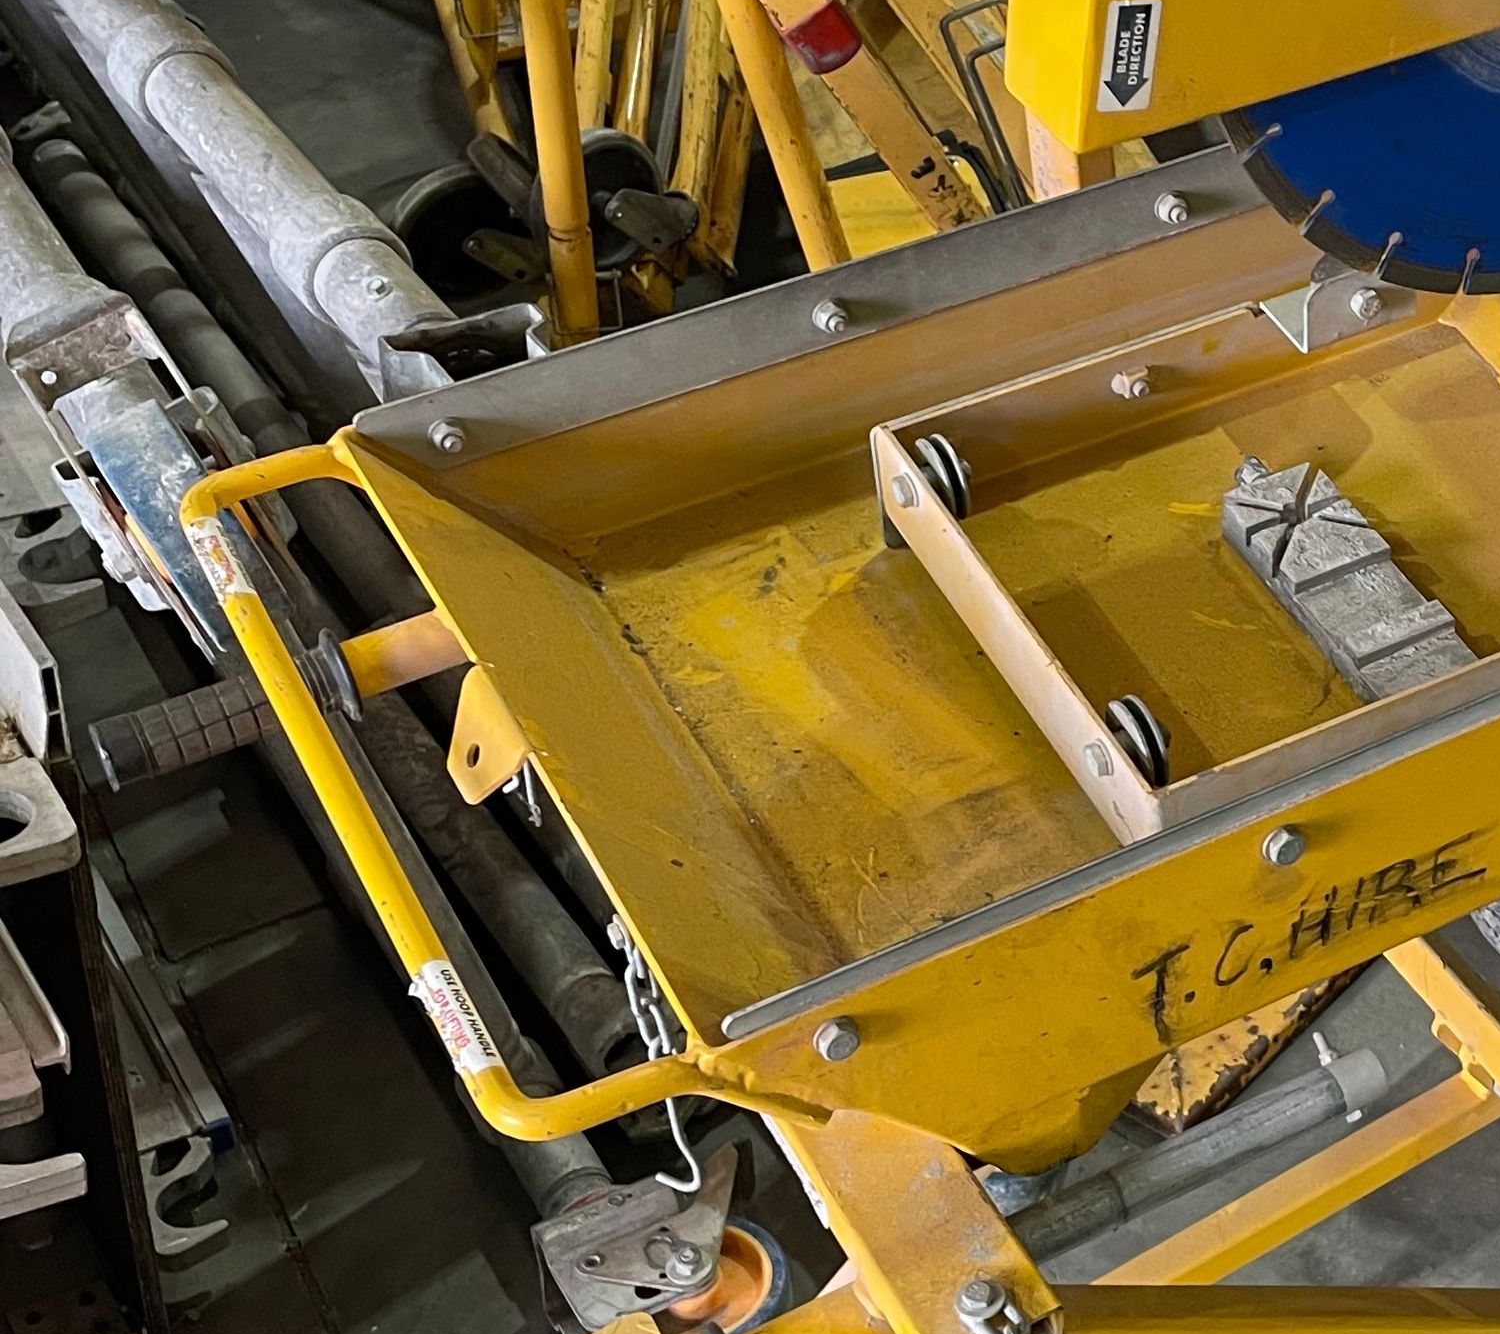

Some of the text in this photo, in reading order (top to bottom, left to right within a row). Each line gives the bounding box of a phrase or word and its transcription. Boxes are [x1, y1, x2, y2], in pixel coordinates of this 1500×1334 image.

[1115, 30, 1131, 74] BLADE
[1127, 12, 1147, 85] DIRECTION
[440, 969, 497, 1058] USE HOOP HANDLE
